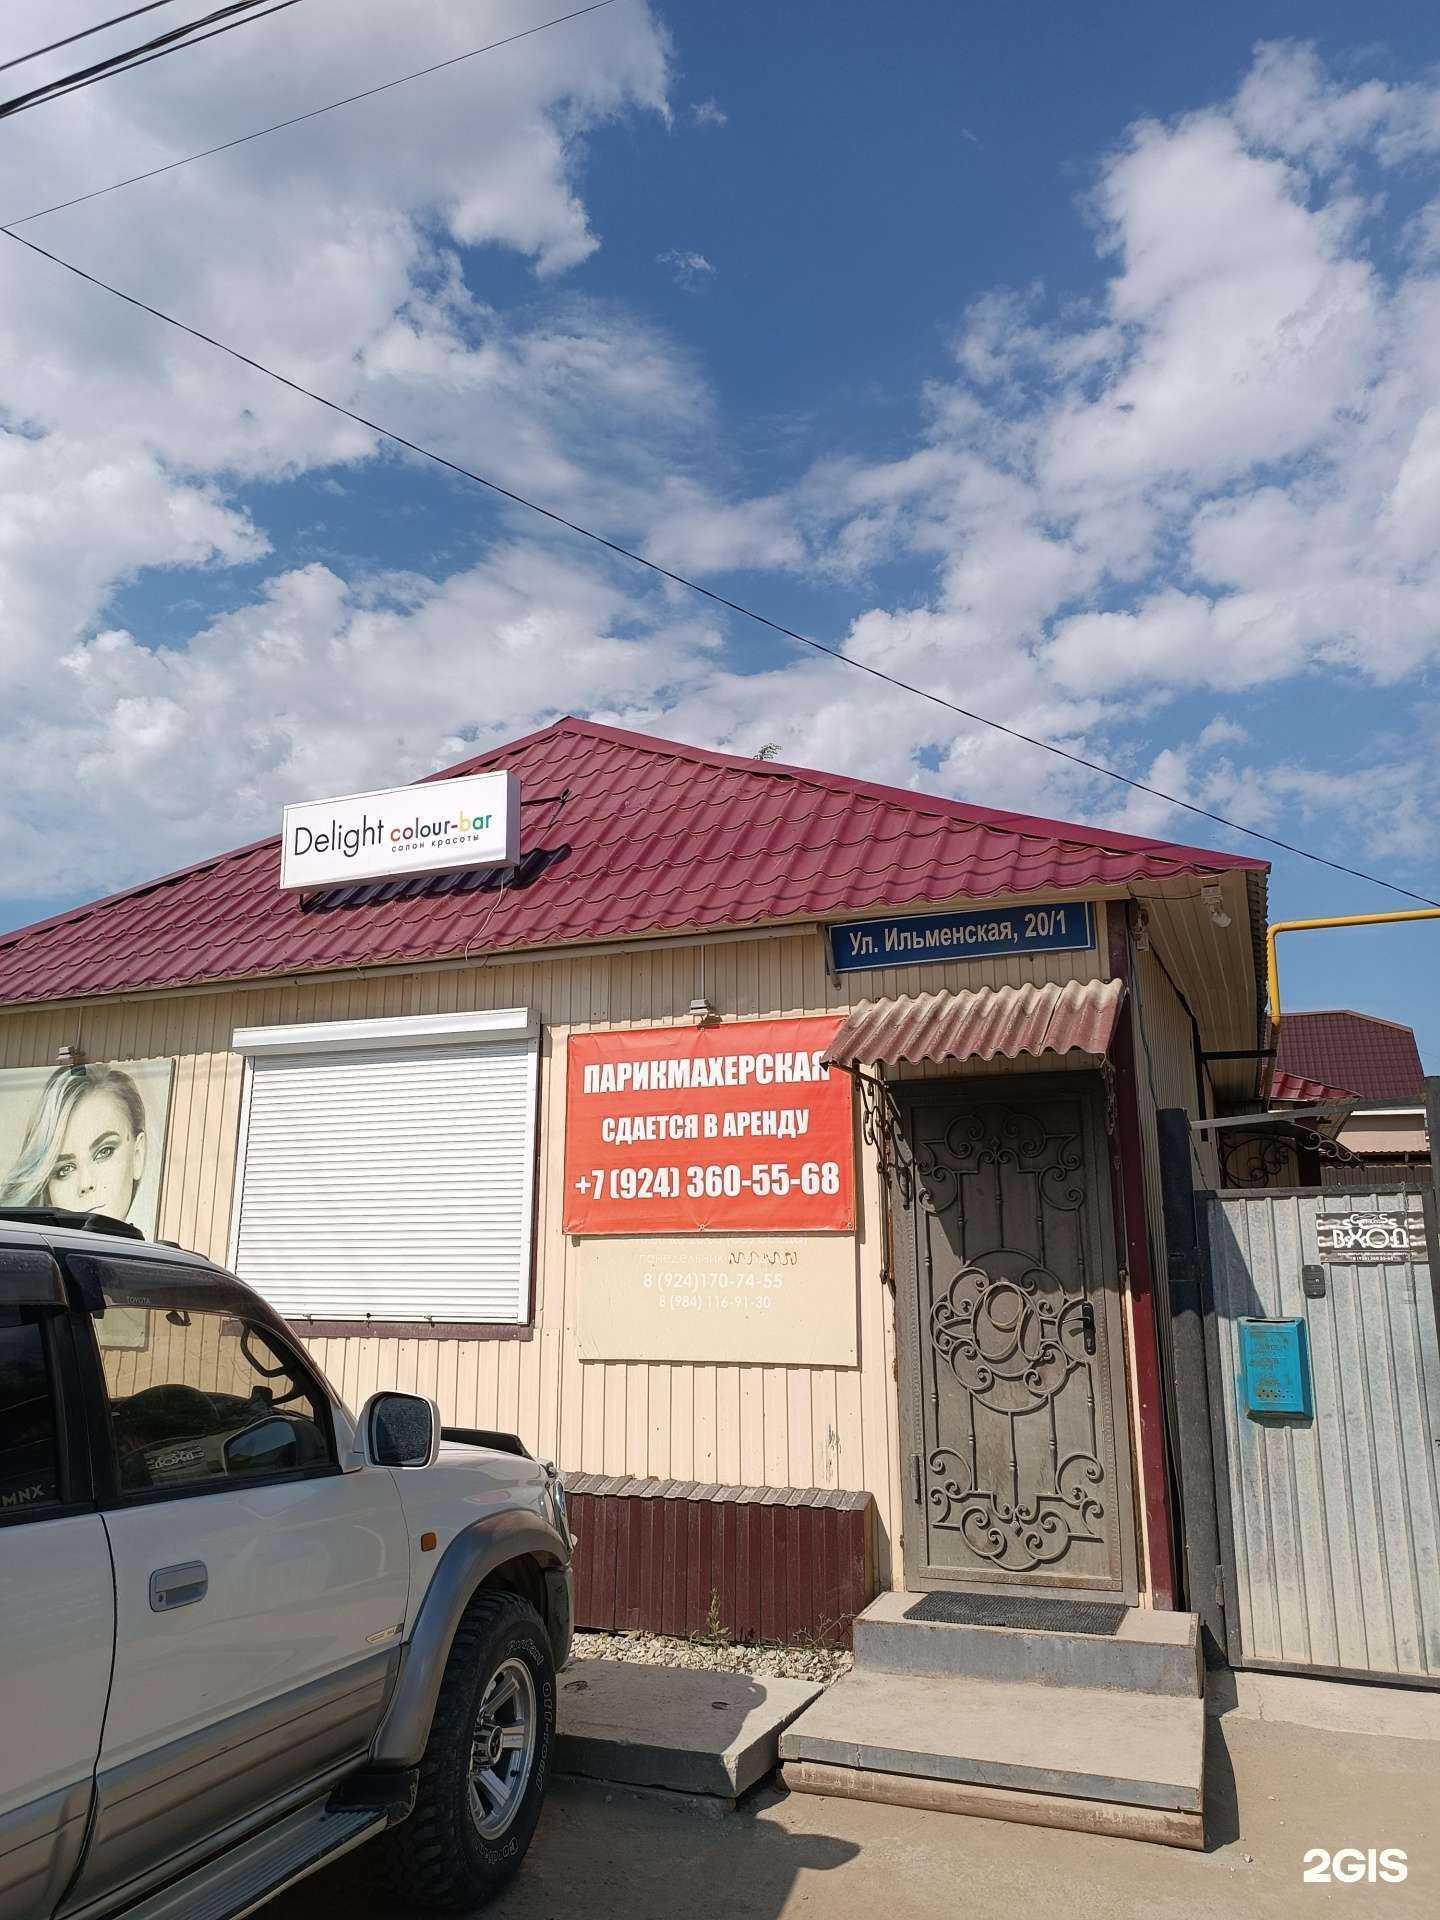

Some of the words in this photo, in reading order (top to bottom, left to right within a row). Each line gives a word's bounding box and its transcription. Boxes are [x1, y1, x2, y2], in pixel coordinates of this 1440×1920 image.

[294, 814, 384, 858] Delight
[390, 810, 493, 842] colour-bar
[391, 841, 425, 853] салон
[431, 834, 480, 848] красоты
[849, 931, 879, 956] Ул.
[884, 921, 1018, 952] Ильменская,
[1024, 910, 1067, 938] 20/1
[583, 1050, 830, 1094] ПАРИКМАХЕРСКАЯ
[601, 1113, 699, 1146] СДАЕТСЯ
[704, 1113, 718, 1138] В
[722, 1108, 810, 1139] АРЕНДУ
[575, 1168, 605, 1200] +7
[609, 1166, 680, 1200] (924)
[686, 1161, 840, 1198] 360-55-68
[643, 1273, 653, 1289] 8
